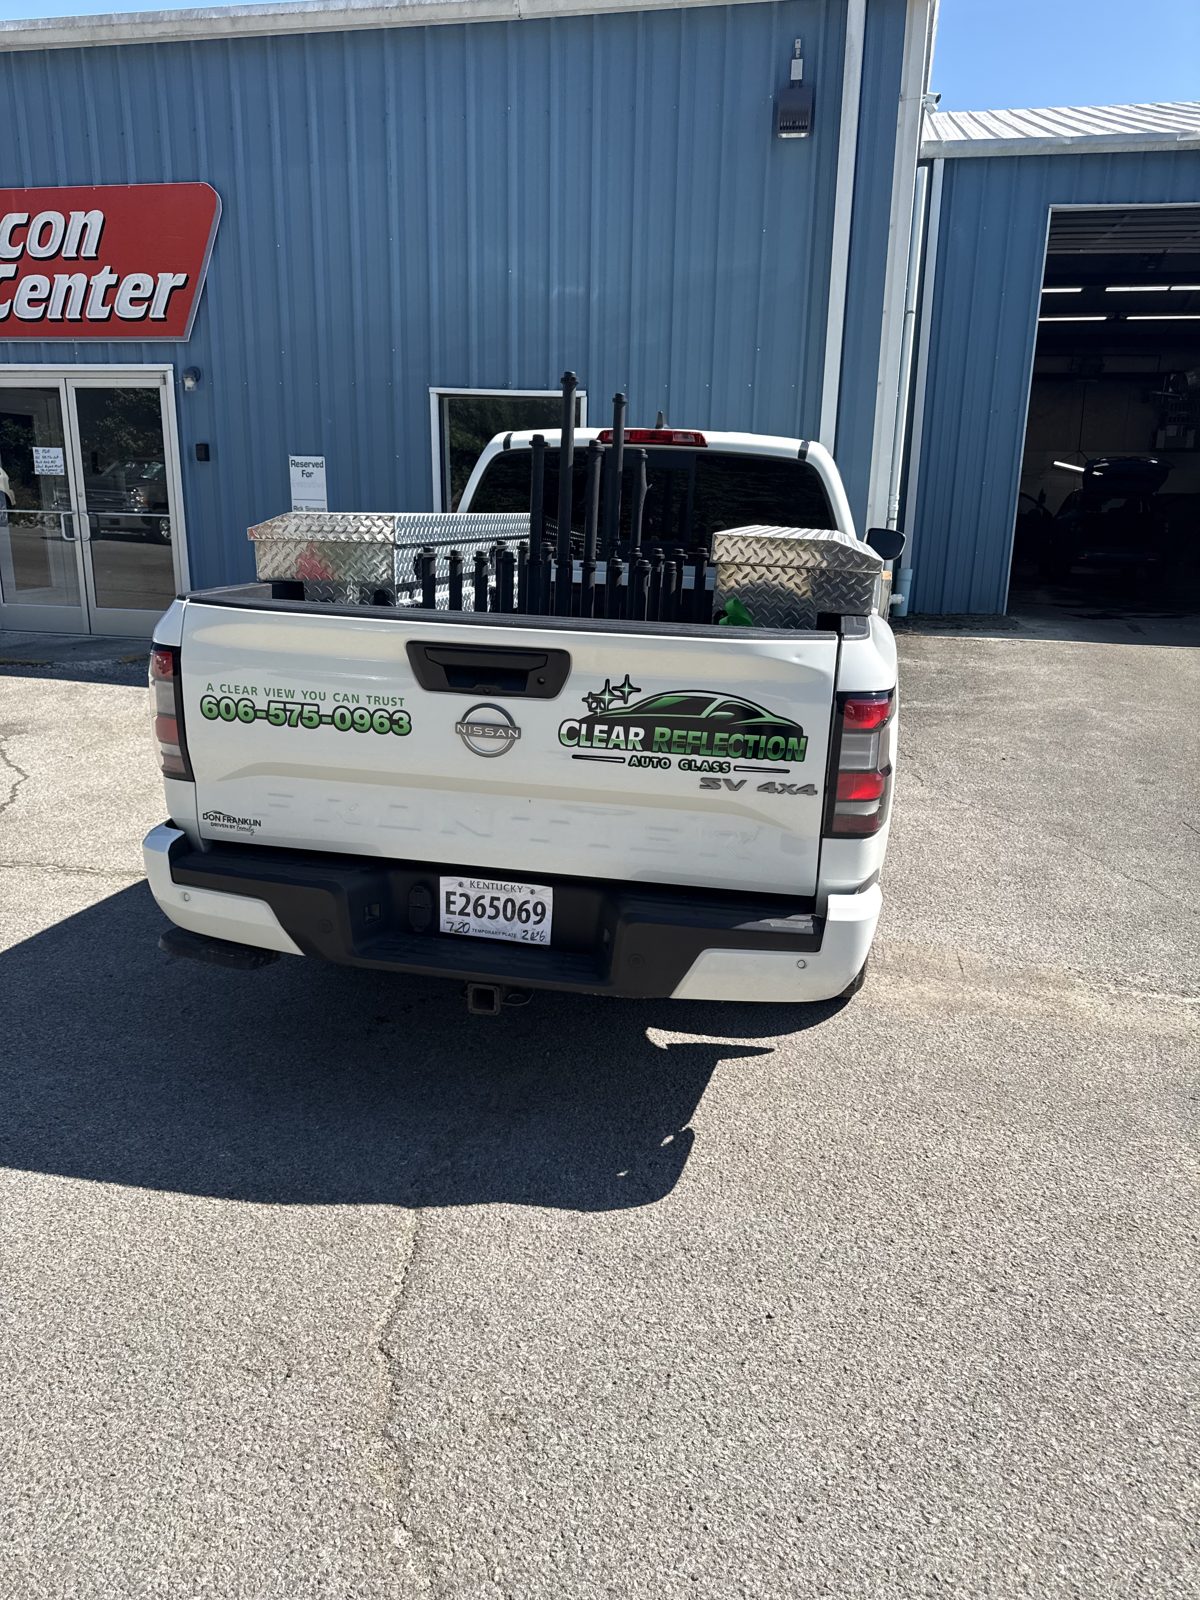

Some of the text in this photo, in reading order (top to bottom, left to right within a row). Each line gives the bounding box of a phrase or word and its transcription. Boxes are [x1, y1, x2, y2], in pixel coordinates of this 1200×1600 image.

[0, 210, 105, 259] con
[290, 459, 324, 468] Reserved
[301, 469, 314, 478] For
[206, 683, 405, 707] A CLEAR VIEW YOU CAN TRUST
[200, 694, 412, 737] 606-575-0963
[456, 724, 519, 738] NISSAN
[559, 719, 808, 762] CLEAR REFLECTION
[628, 755, 732, 773] AUTO GLASS
[699, 776, 748, 791] SV
[202, 812, 262, 827] DON FRANKLIN
[469, 880, 524, 893] KENTUCKY
[445, 890, 547, 926] E265069
[471, 928, 517, 939] TEMPORARY PLATE
